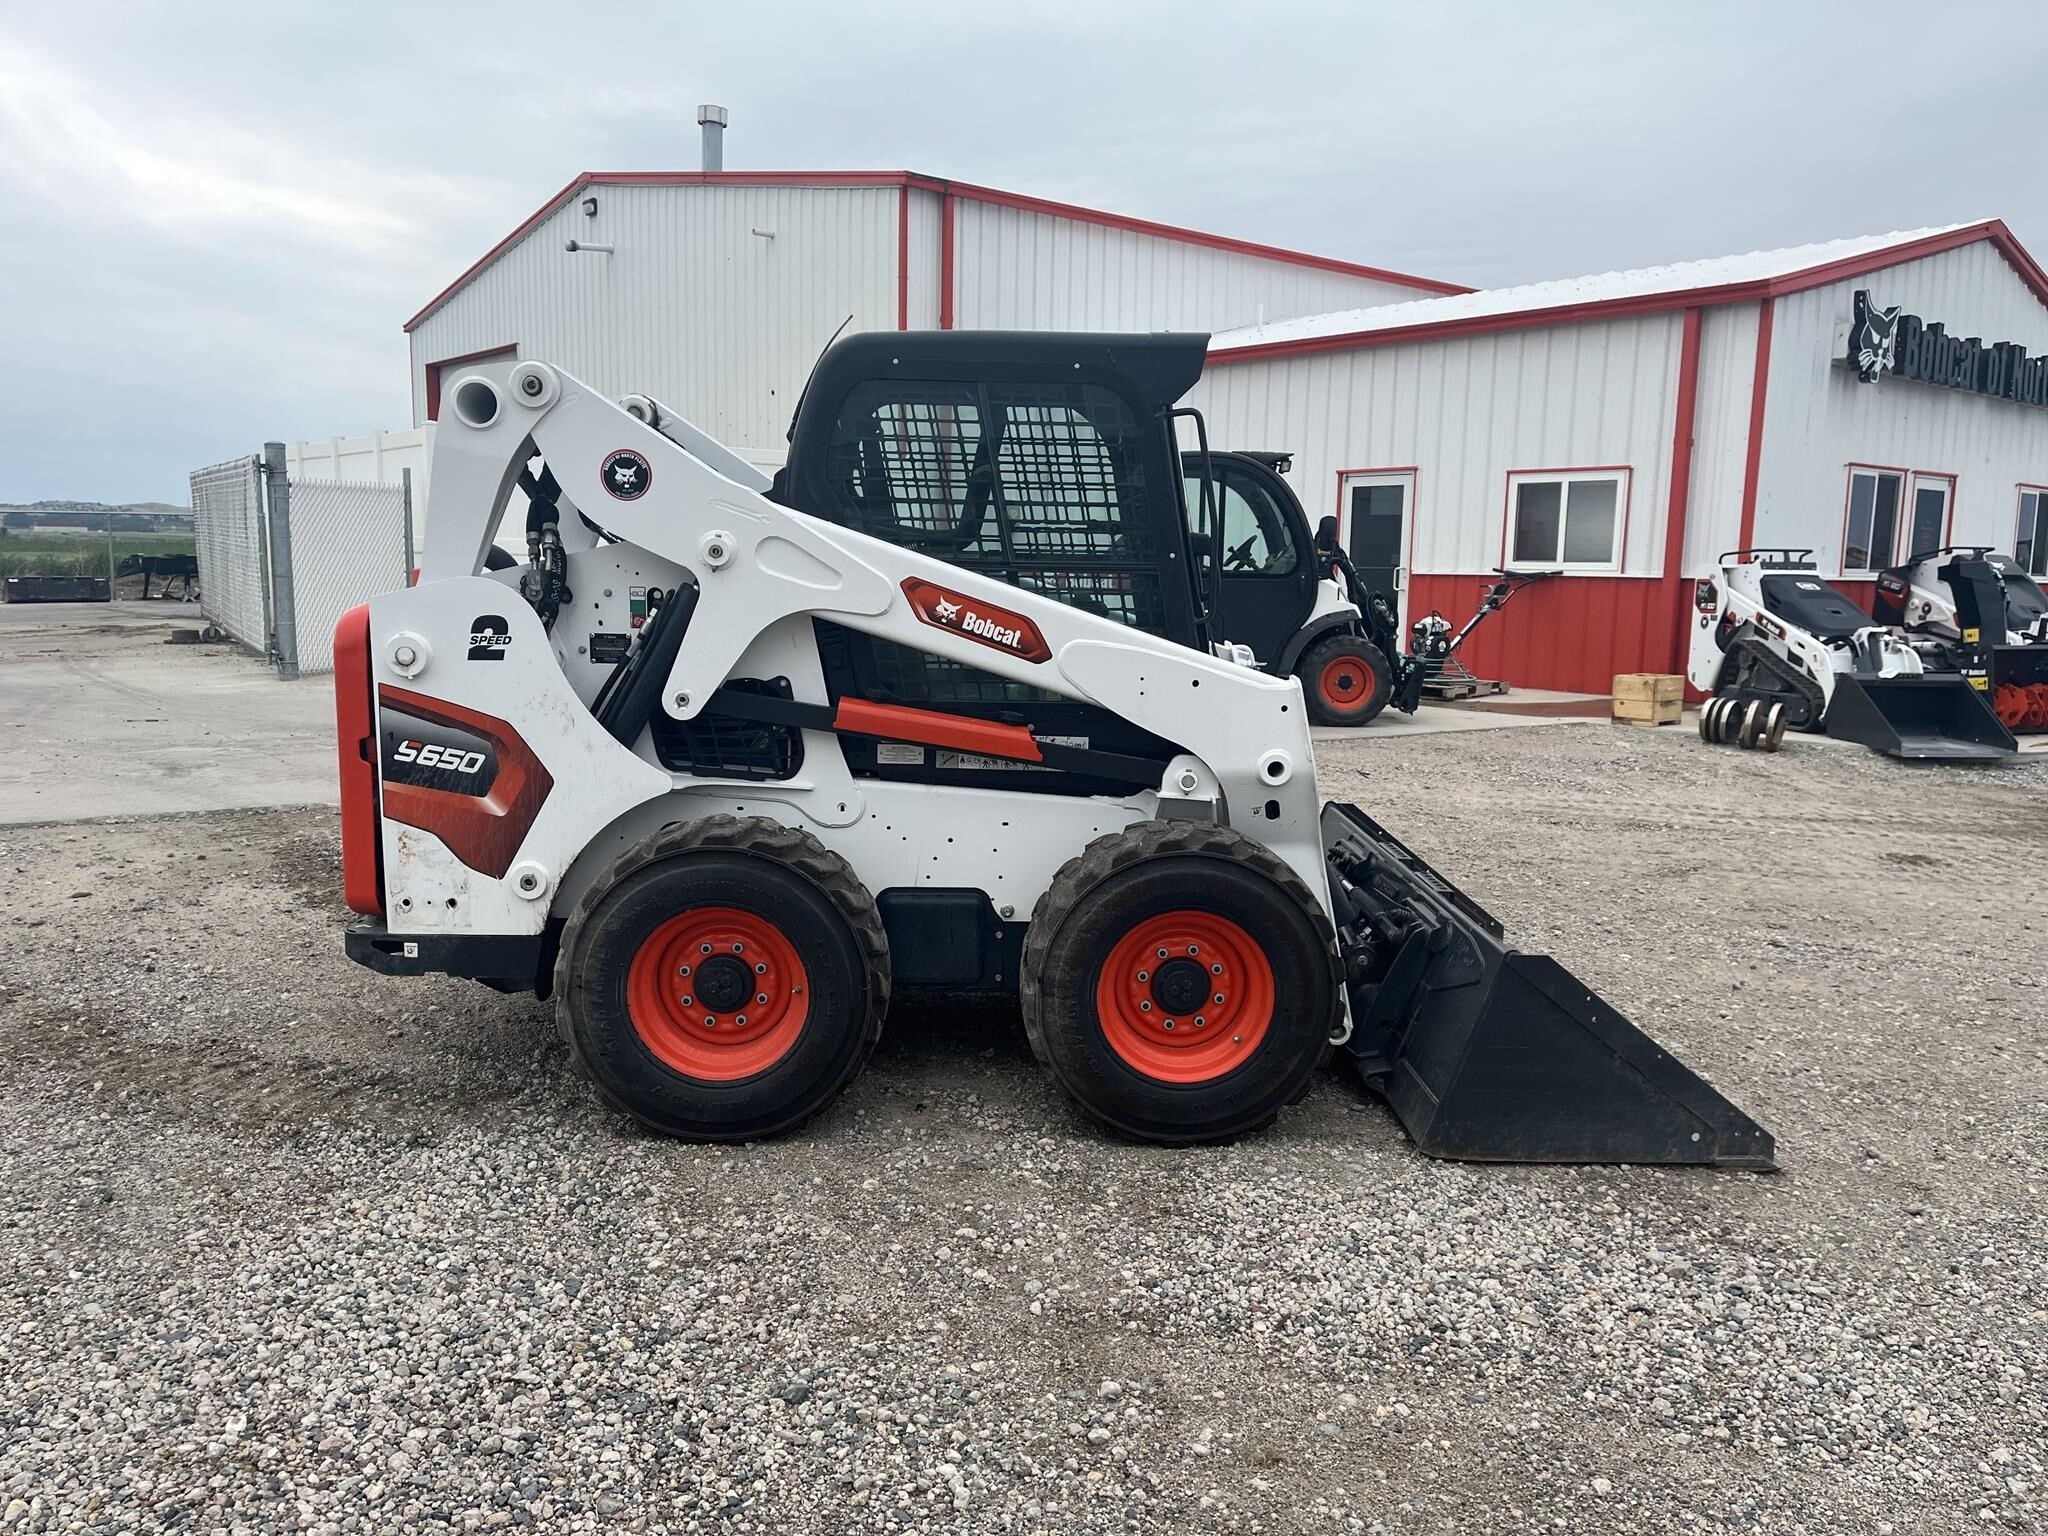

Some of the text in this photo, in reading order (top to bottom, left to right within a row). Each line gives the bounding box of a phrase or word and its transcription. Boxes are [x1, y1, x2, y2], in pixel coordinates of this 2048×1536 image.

[1900, 315, 1982, 393] Bobcat
[1986, 341, 2009, 398] of
[467, 614, 509, 661] 2
[469, 635, 512, 645] SPEED
[962, 611, 1021, 648] Bobcat
[393, 740, 486, 774] S650
